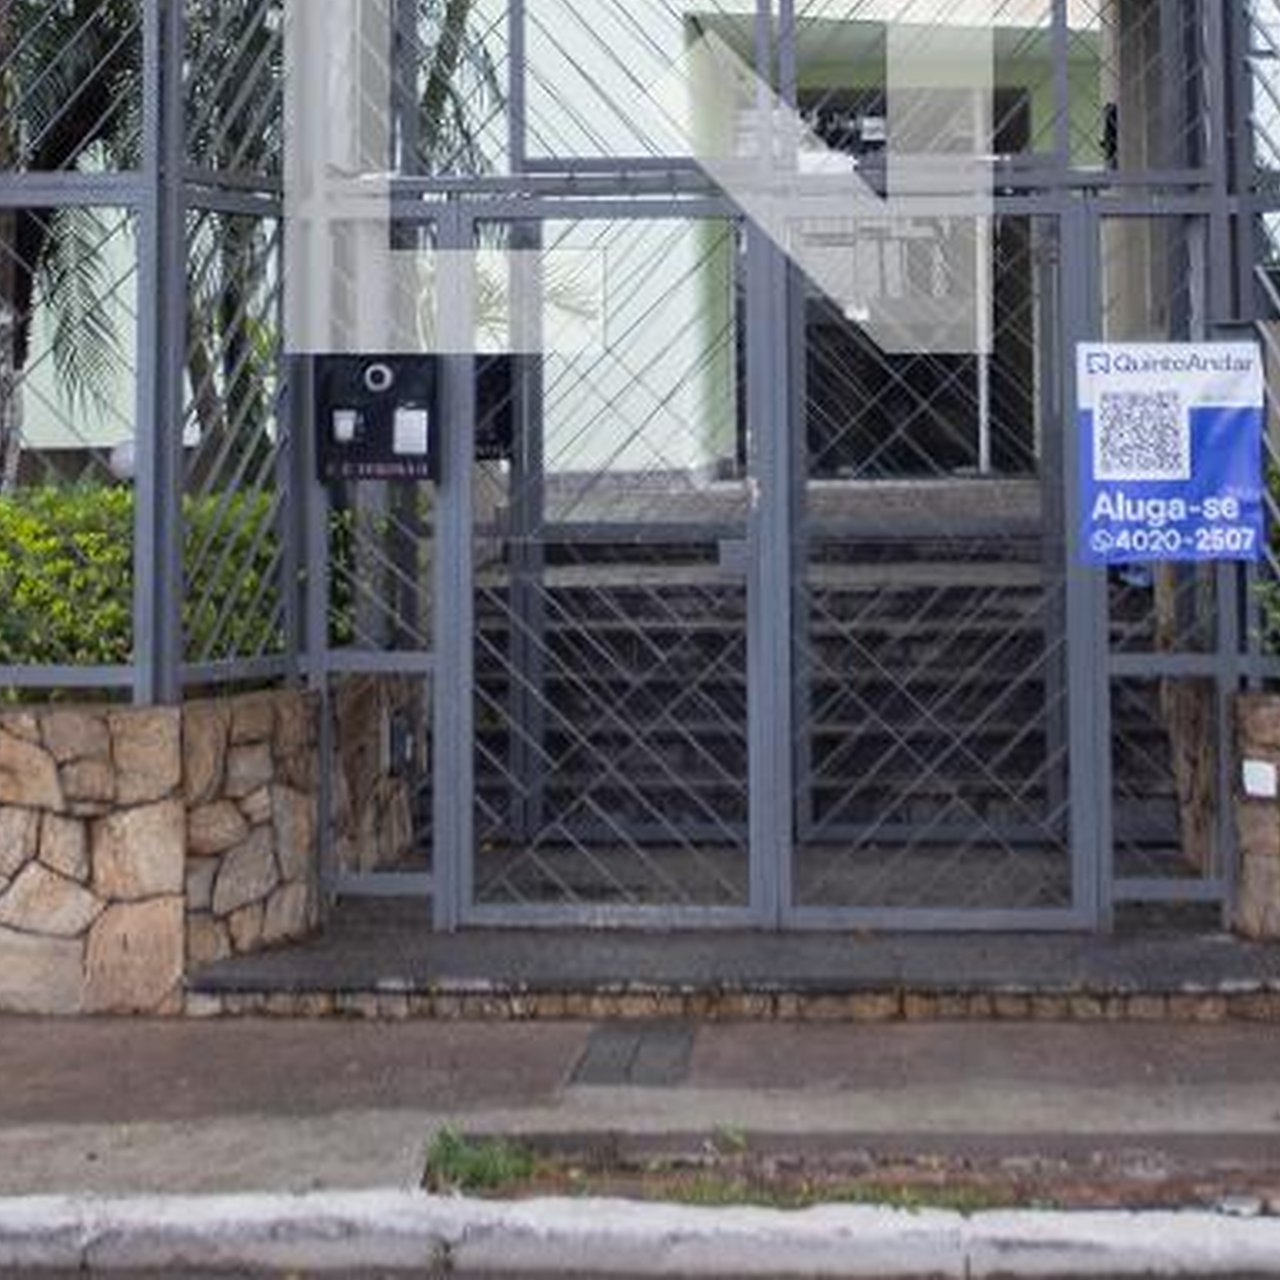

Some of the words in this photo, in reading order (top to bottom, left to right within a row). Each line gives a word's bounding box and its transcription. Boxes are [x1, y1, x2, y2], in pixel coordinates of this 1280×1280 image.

[1112, 353, 1253, 372] QuintoAndar
[1092, 491, 1239, 527] Aluga-se
[1115, 528, 1256, 552] 4020-2507
